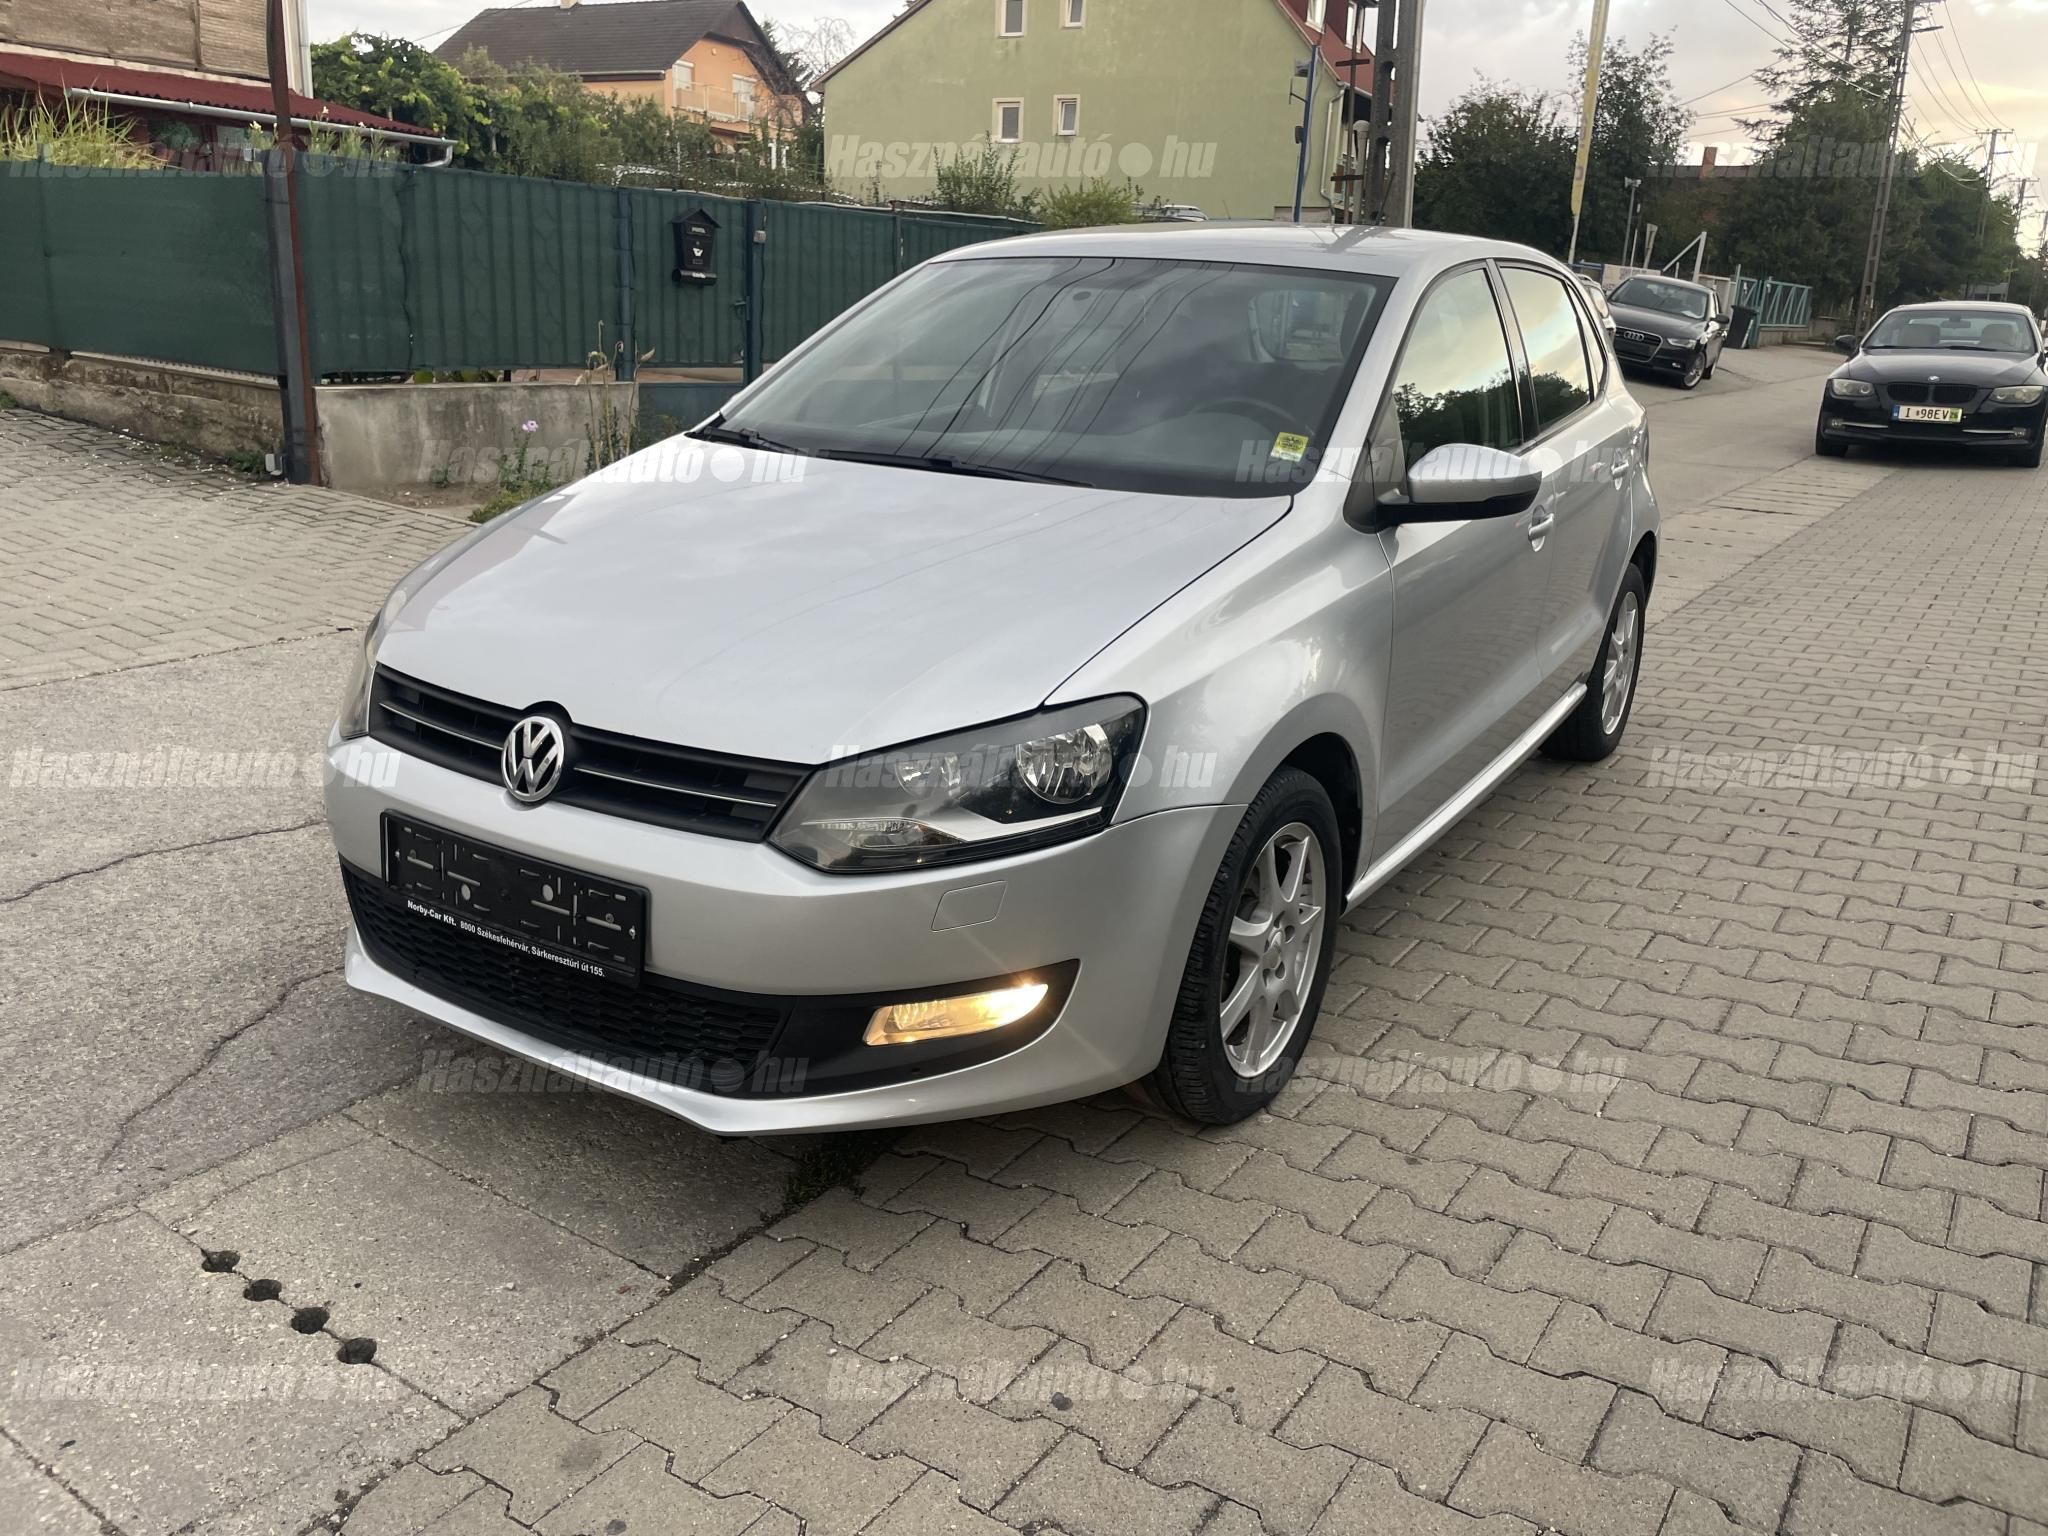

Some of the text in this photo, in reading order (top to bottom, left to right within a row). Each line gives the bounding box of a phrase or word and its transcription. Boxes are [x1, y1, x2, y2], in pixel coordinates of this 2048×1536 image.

[407, 900, 606, 978] Norby-Car Kft. 8000 Székesfehérvár, Sárkeresztúri út 155.
